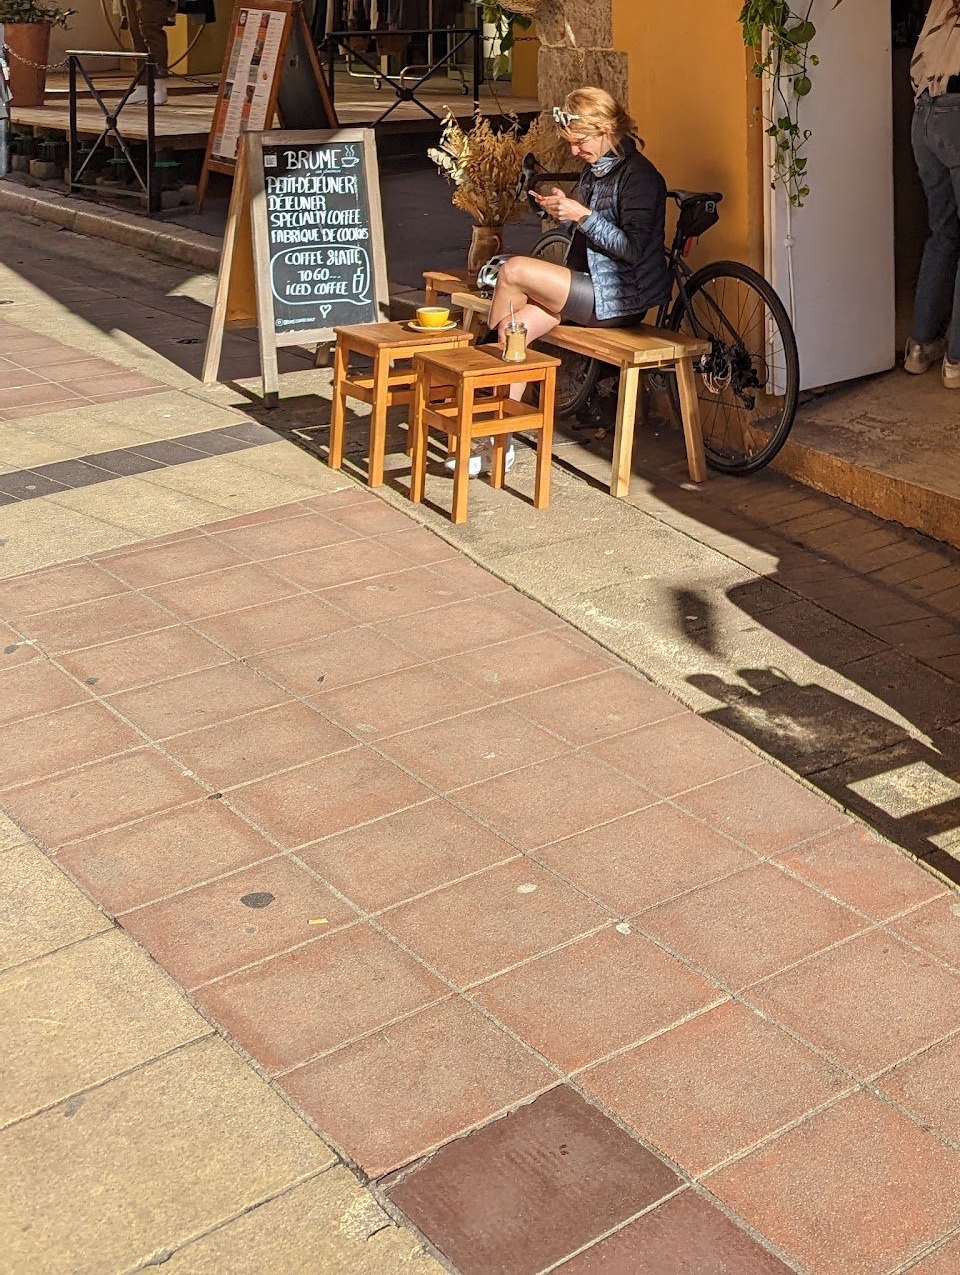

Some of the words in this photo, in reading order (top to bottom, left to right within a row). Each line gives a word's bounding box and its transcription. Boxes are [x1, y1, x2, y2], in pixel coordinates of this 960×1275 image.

[283, 149, 342, 169] BRUME
[268, 194, 326, 211] DÉJEUNER
[327, 209, 362, 225] COFFEE
[271, 227, 321, 243] FABRIQUE
[322, 228, 337, 242] DE
[285, 250, 324, 265] COFFEE
[297, 270, 312, 281] TO
[314, 281, 348, 295] COFFEE
